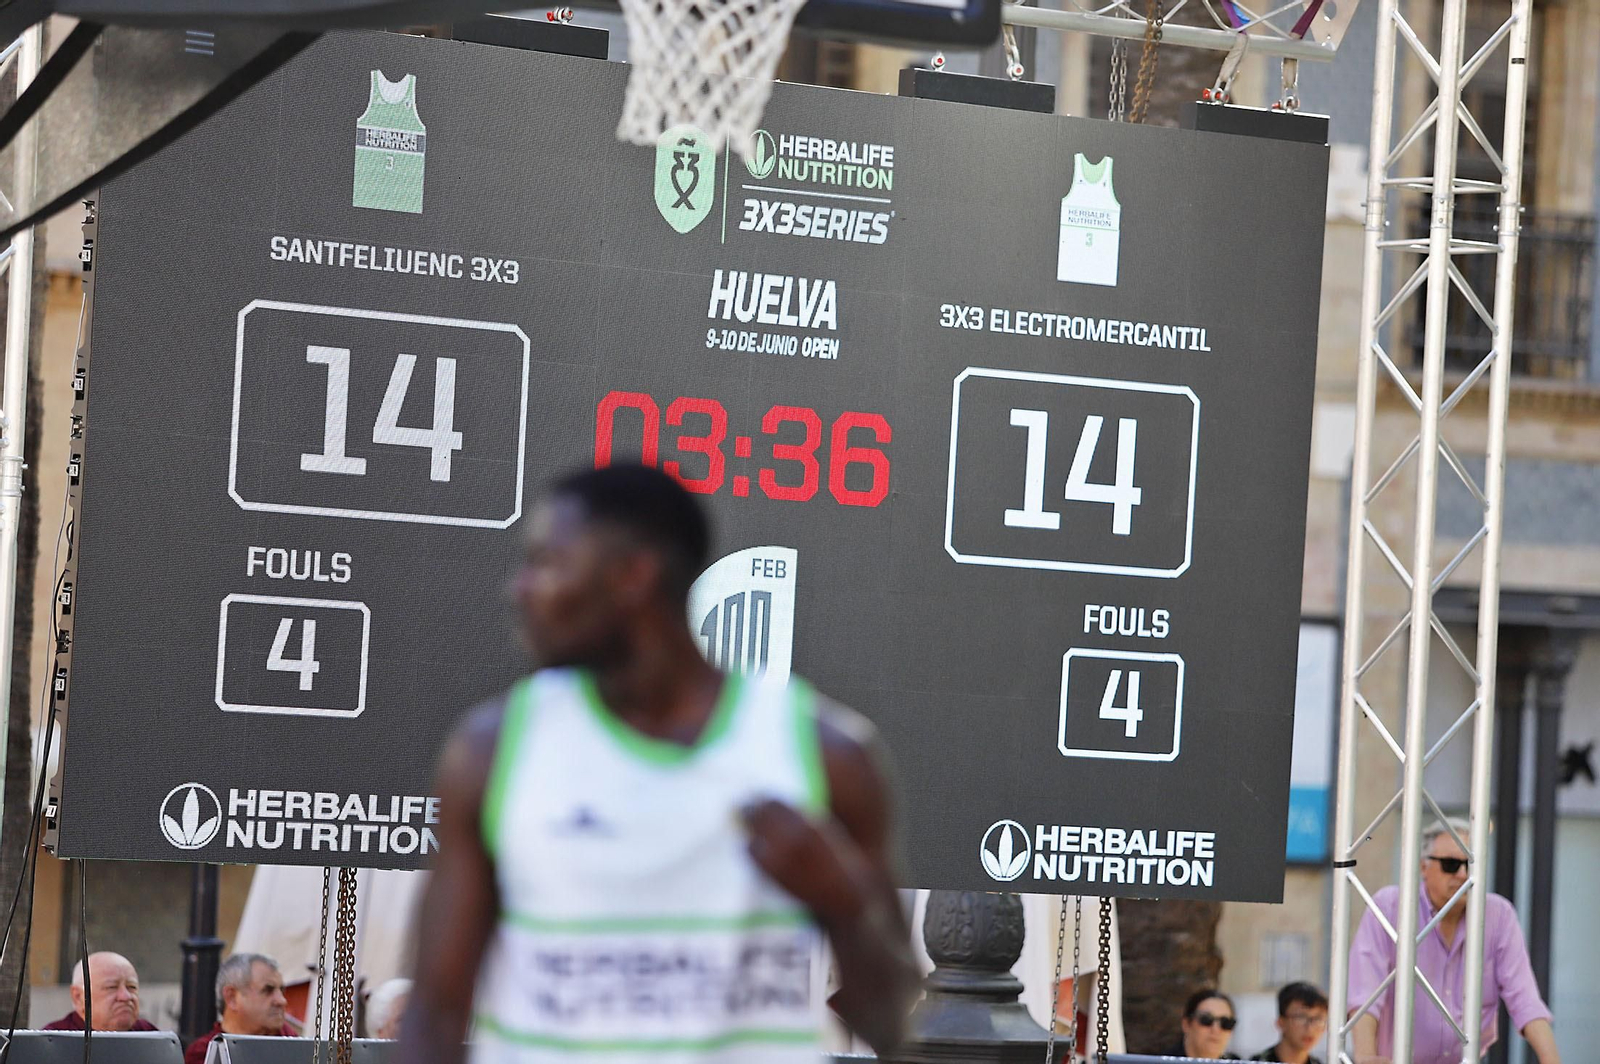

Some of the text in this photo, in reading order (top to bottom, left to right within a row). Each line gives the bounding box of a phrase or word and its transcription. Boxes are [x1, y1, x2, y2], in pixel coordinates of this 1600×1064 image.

[385, 156, 395, 170] 3
[779, 133, 894, 168] HERBALIFE
[777, 158, 894, 191] NUTRITION
[738, 198, 889, 245] 3X3SERIES
[1085, 232, 1094, 248] 3
[269, 235, 520, 285] SANTFELIUENC 3X3
[707, 268, 838, 331] HUELVA
[939, 303, 1212, 352] 3X3 ELECTROMERCANTIL
[757, 333, 798, 356] JUNIO
[801, 335, 840, 360] OPEN
[300, 344, 464, 483] 14
[593, 390, 893, 508] 03:36
[1003, 407, 1142, 536] 14
[246, 545, 353, 584] FOULS
[751, 557, 787, 579] FEB
[1083, 603, 1171, 639] FOULS
[266, 617, 321, 692] 4
[1098, 669, 1144, 738] 4
[227, 788, 442, 825] HERBALIFE
[225, 819, 441, 855] NUTRITION
[1034, 824, 1216, 859] HERBALIFE
[1032, 853, 1214, 887] NUTRITION
